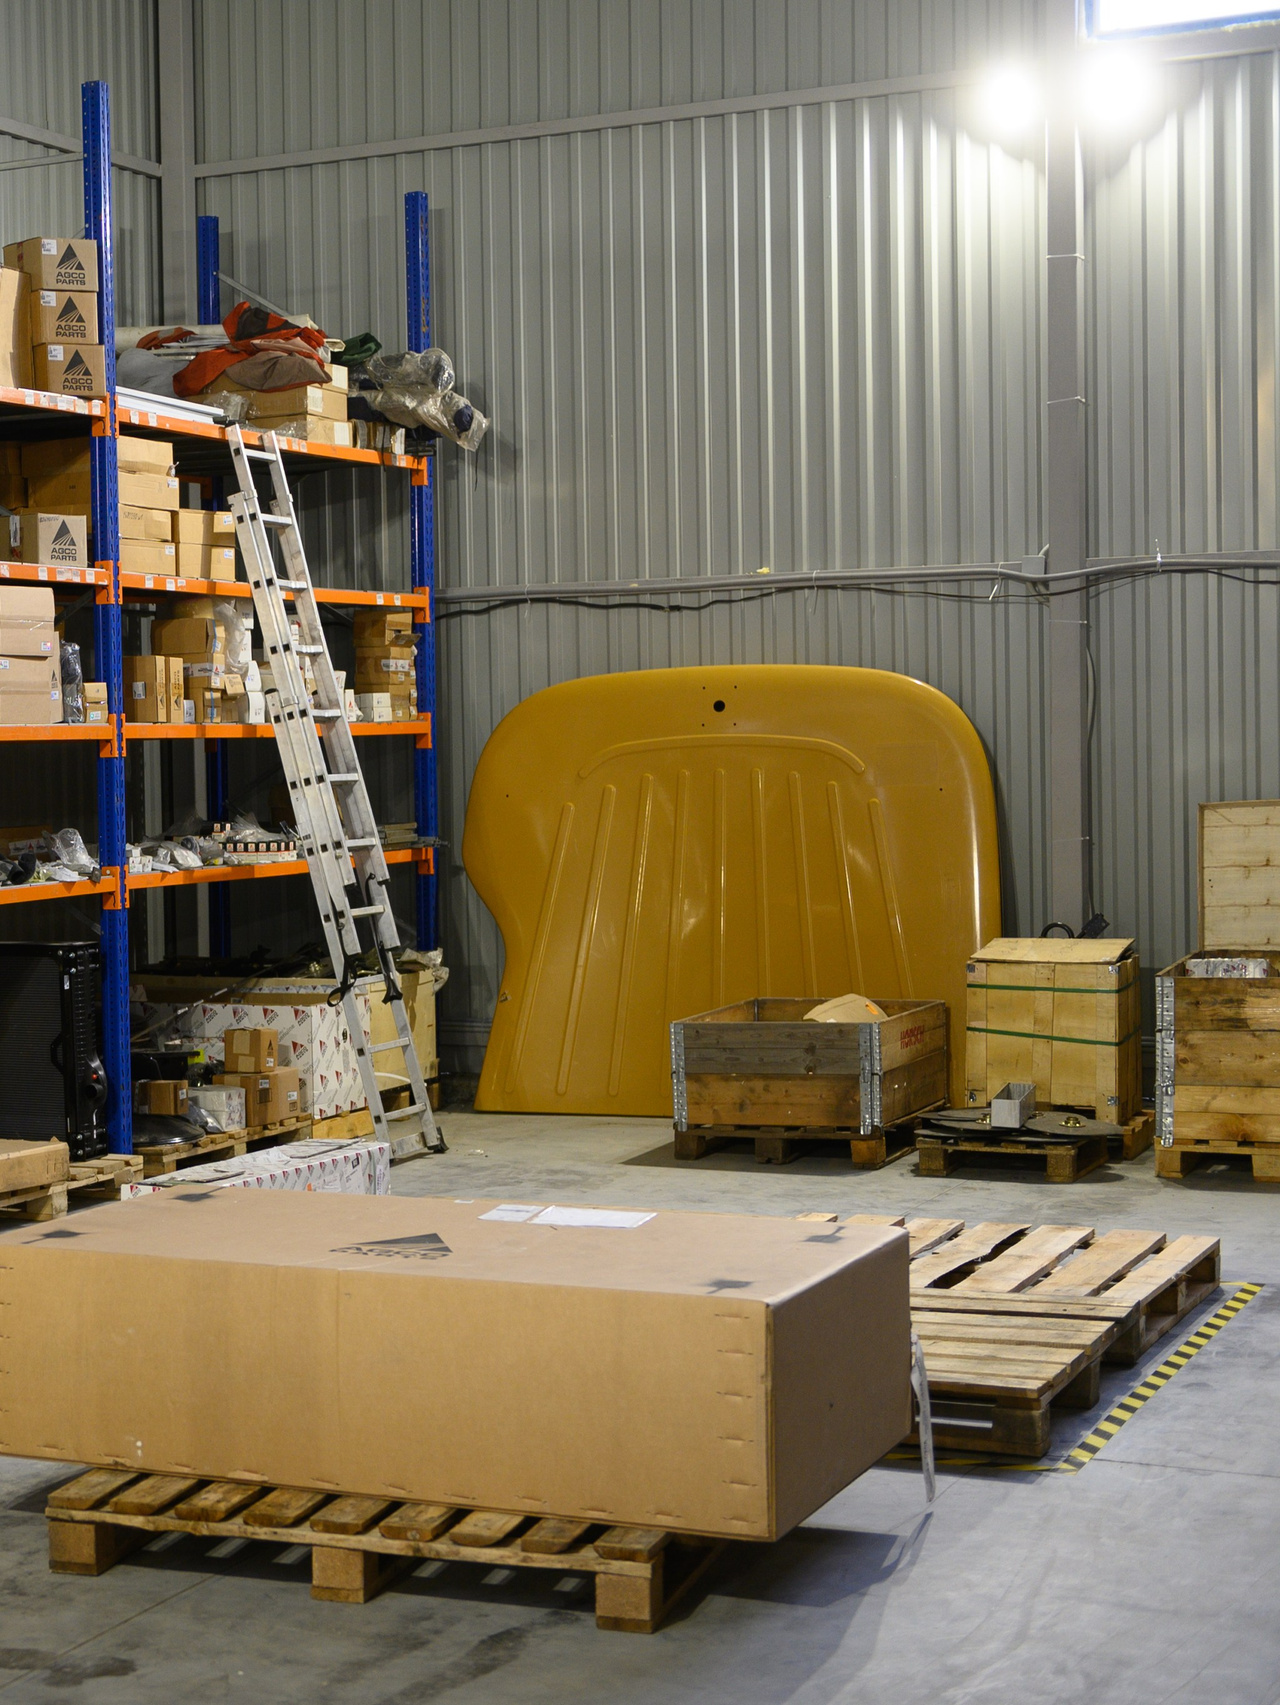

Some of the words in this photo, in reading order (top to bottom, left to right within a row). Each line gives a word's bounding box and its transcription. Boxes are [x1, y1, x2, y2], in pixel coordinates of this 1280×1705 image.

[56, 271, 86, 280] AGCO
[55, 278, 86, 286] PARTS
[56, 324, 86, 332] AGCO
[55, 331, 87, 339] PARTS
[63, 377, 93, 385] AGCO
[62, 384, 93, 392] PARTS
[51, 547, 77, 555] AGCO
[278, 1024, 296, 1042] enuine
